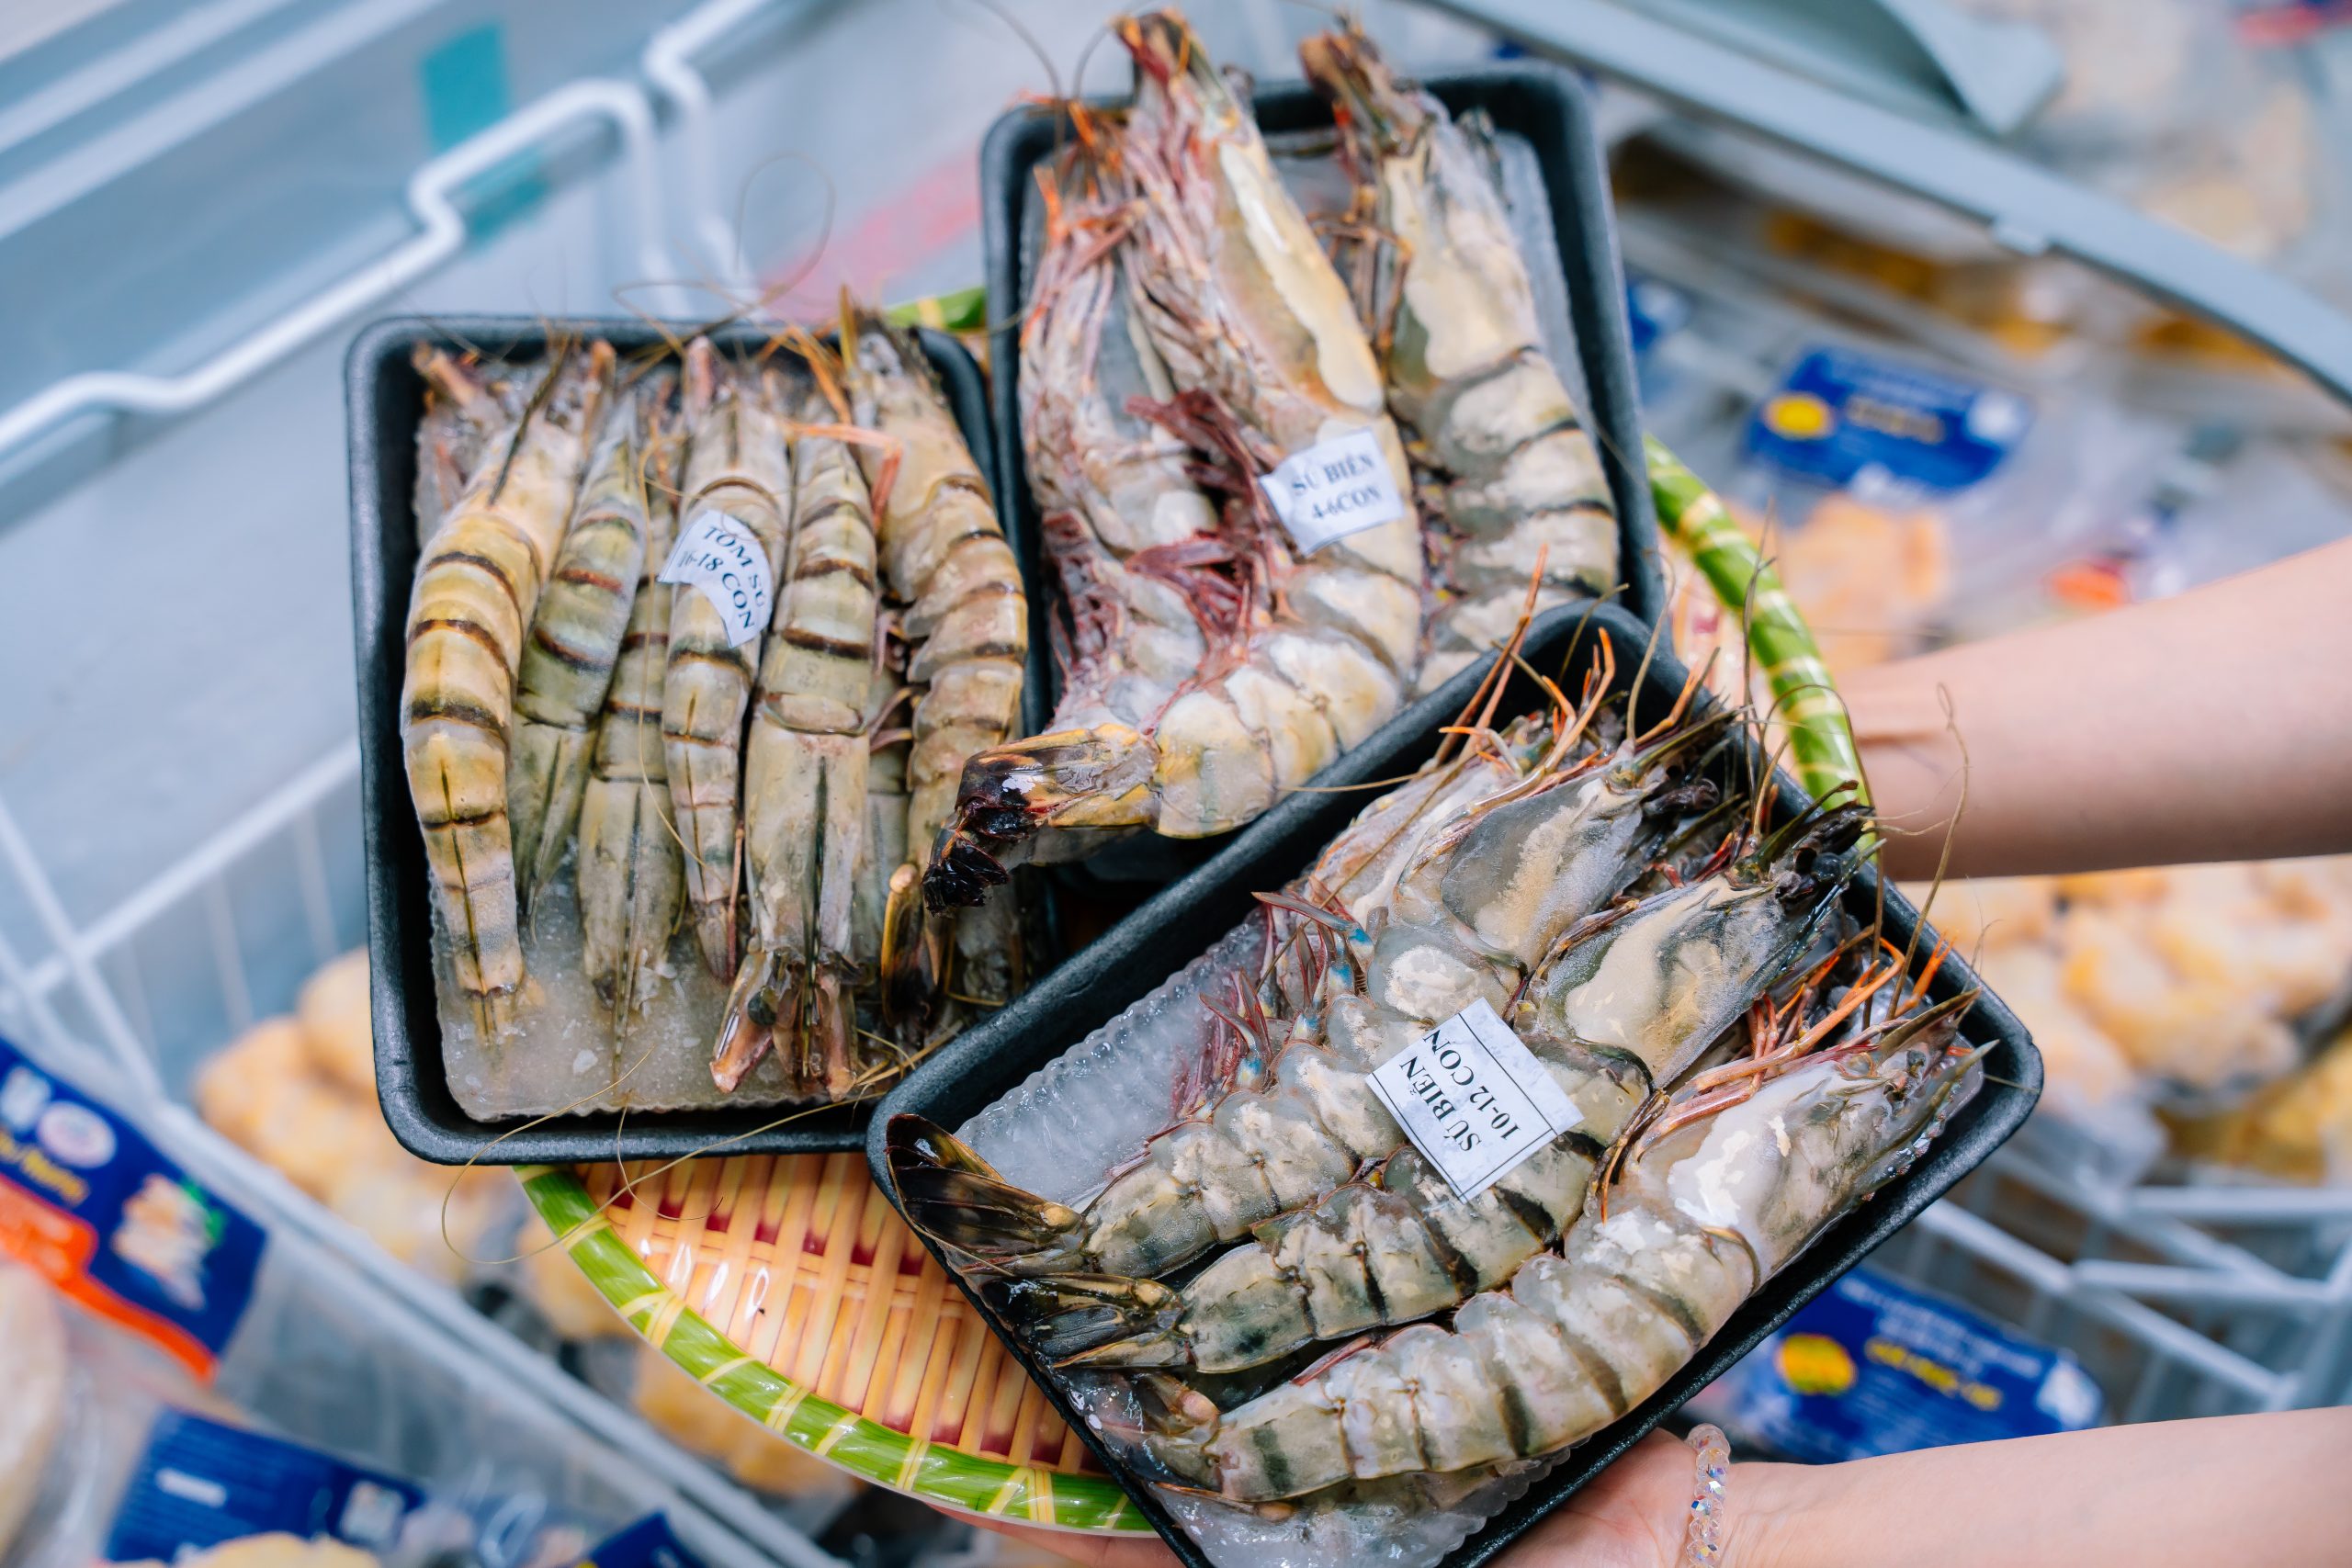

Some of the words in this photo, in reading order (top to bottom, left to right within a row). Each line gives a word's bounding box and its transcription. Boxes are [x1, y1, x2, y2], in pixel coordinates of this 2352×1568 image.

[722, 572, 754, 628] CON
[1423, 1029, 1475, 1087] CON
[1398, 1055, 1457, 1122] BIỂN
[1469, 1086, 1521, 1141] 10-12
[1443, 1119, 1483, 1152] SÚ
